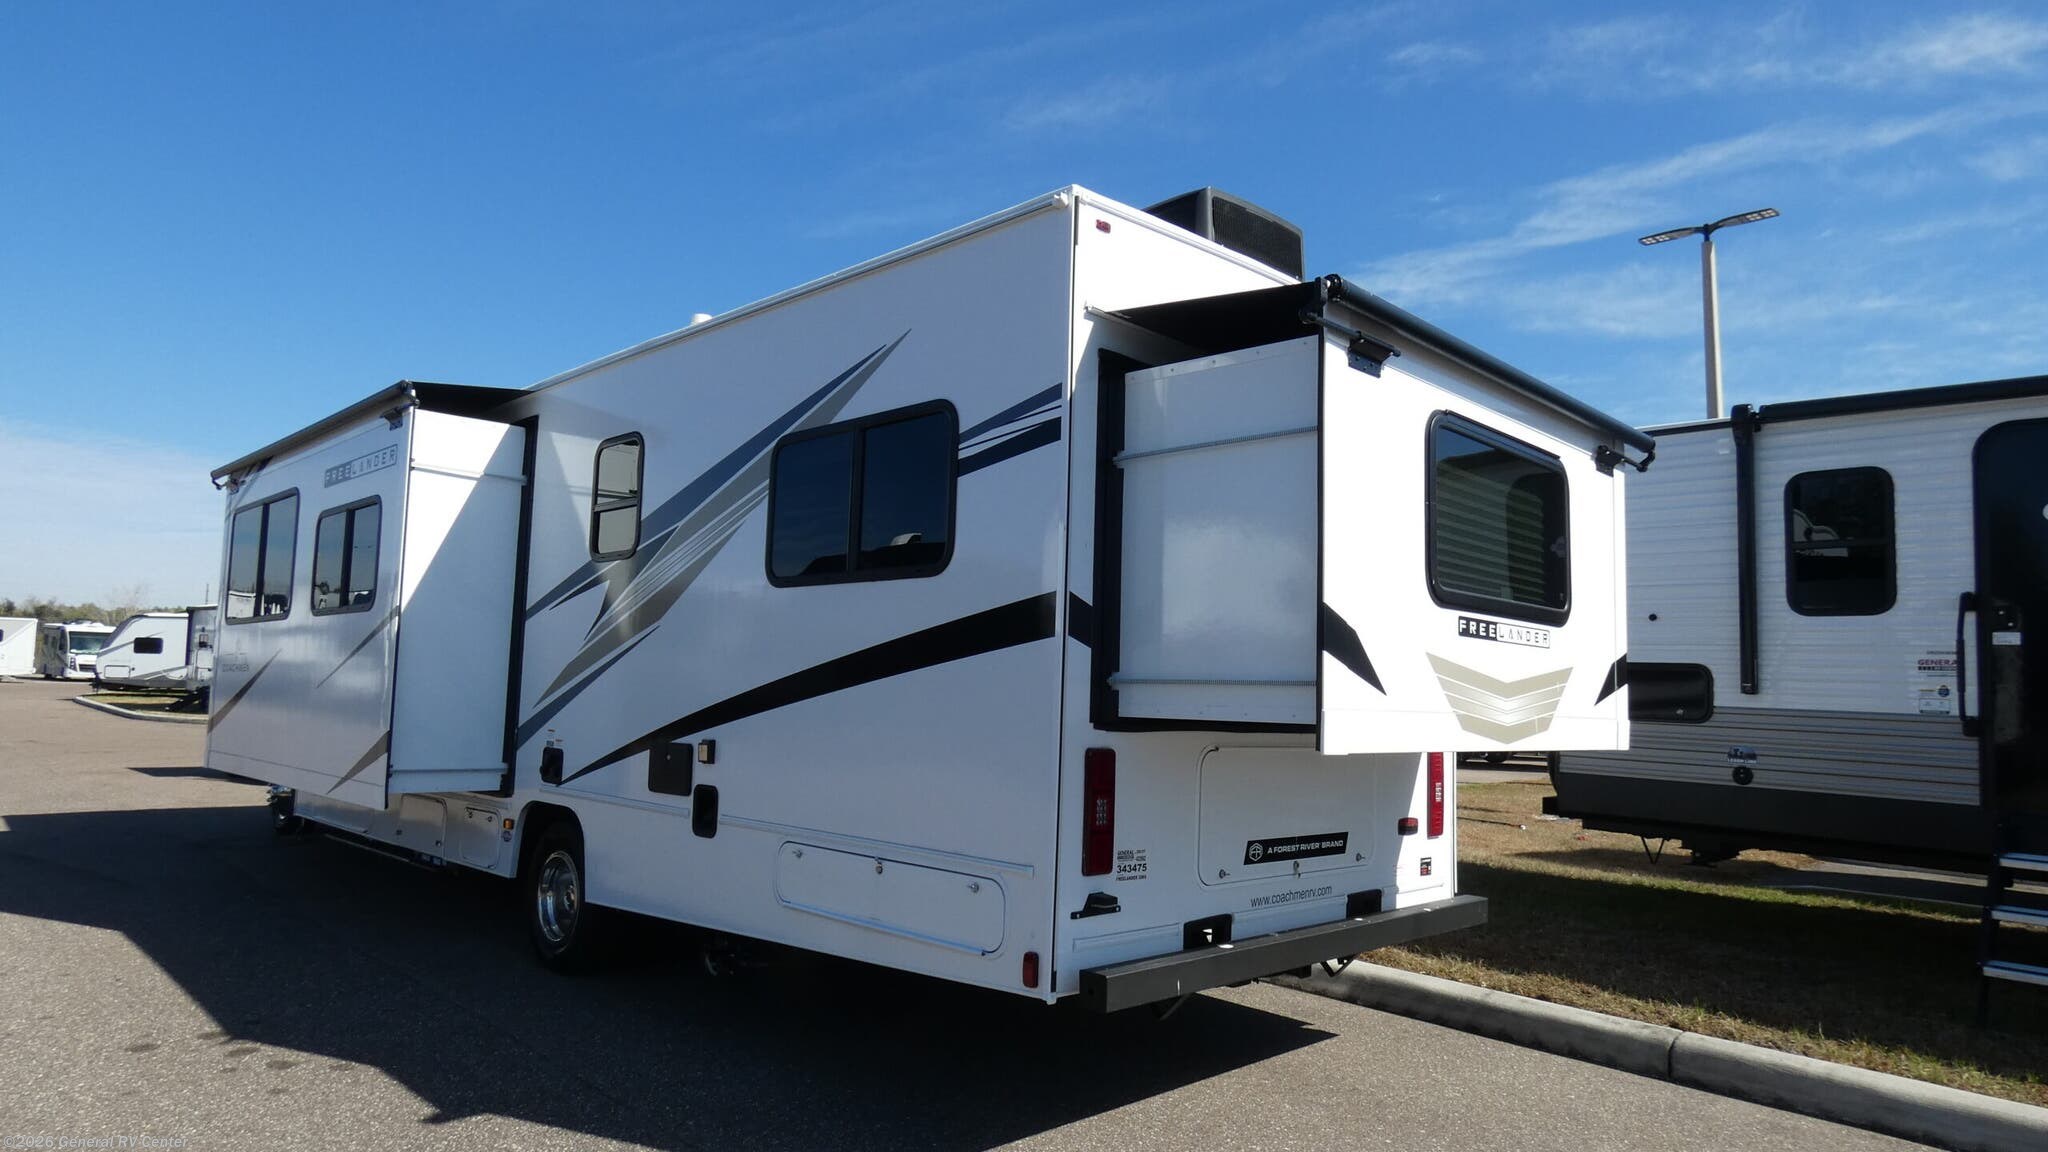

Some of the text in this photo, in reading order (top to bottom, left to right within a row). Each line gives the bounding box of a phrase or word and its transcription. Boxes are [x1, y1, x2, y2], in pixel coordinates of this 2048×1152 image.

[325, 448, 396, 481] FREELANDER
[1459, 619, 1548, 644] FREELANDER
[1273, 843, 1300, 854] FOREST
[1321, 839, 1345, 849] BRAND
[1116, 863, 1148, 874] 343475
[1250, 885, 1333, 908] www.coachmenrv.com
